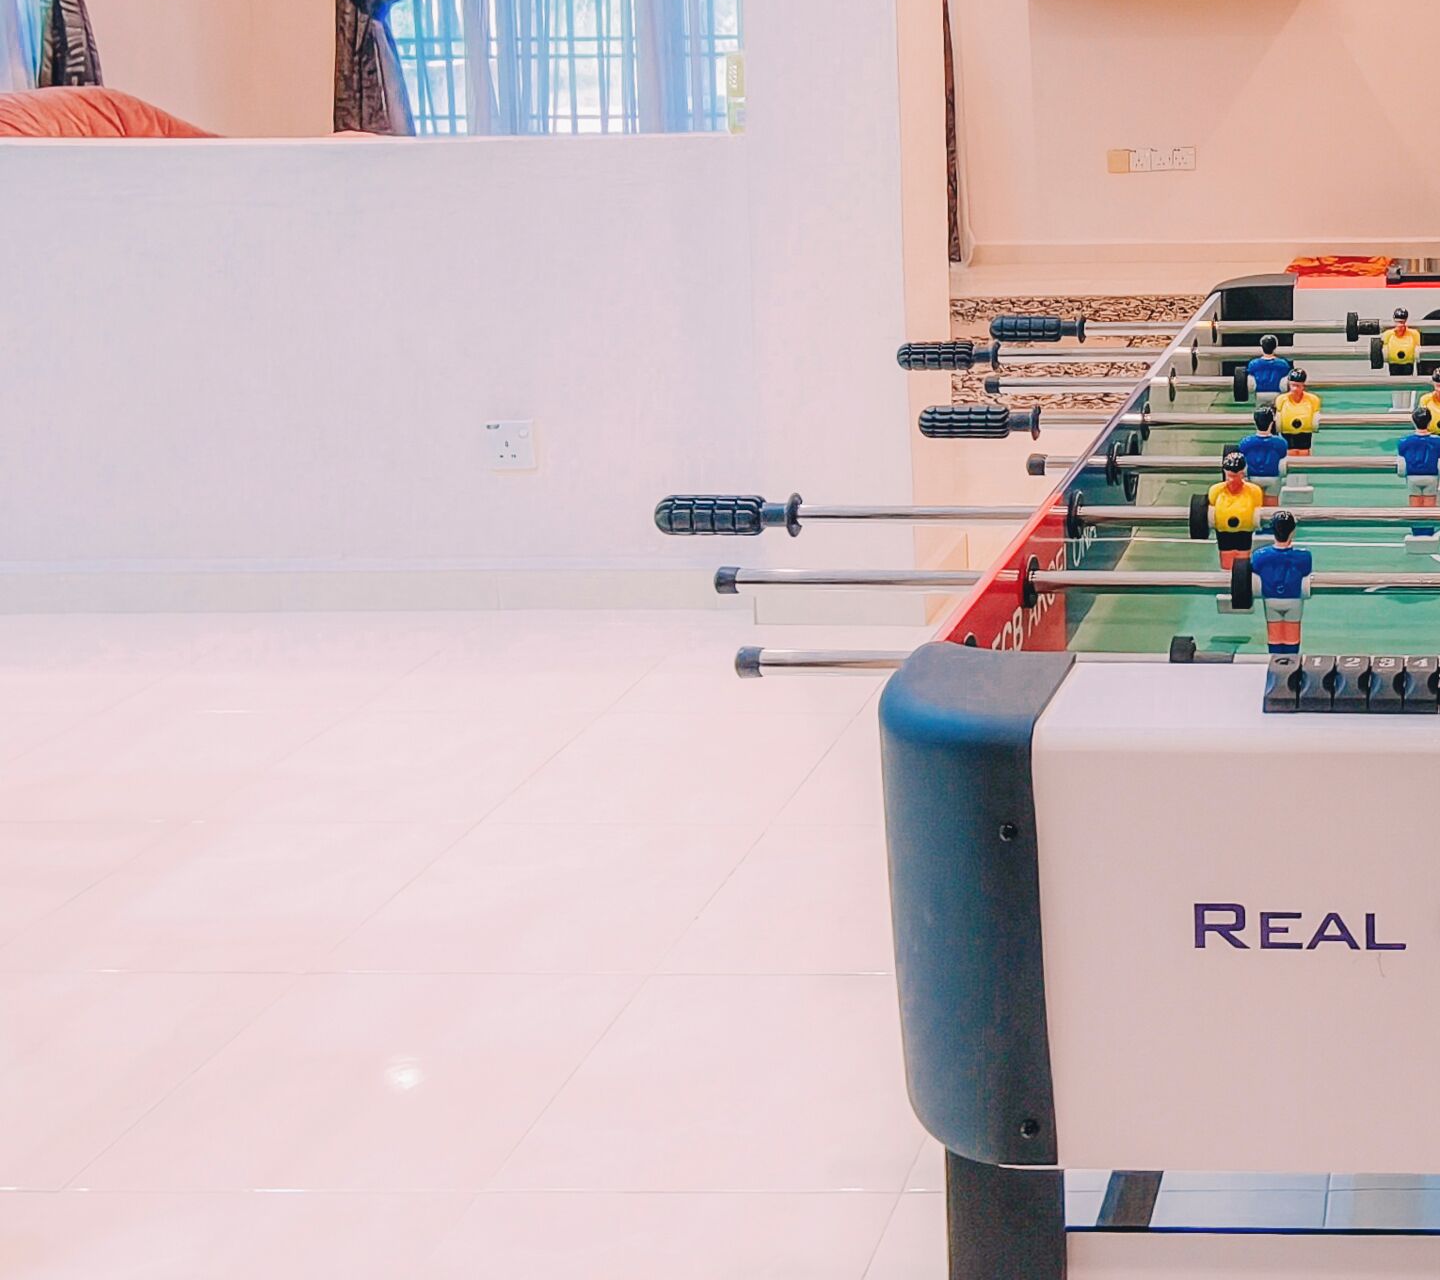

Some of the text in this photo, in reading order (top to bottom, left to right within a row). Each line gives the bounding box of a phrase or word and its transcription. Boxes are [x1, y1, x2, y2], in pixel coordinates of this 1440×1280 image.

[1311, 657, 1323, 666] 1
[1345, 657, 1361, 667] 2
[1379, 657, 1395, 667] 3
[1413, 658, 1428, 667] 4
